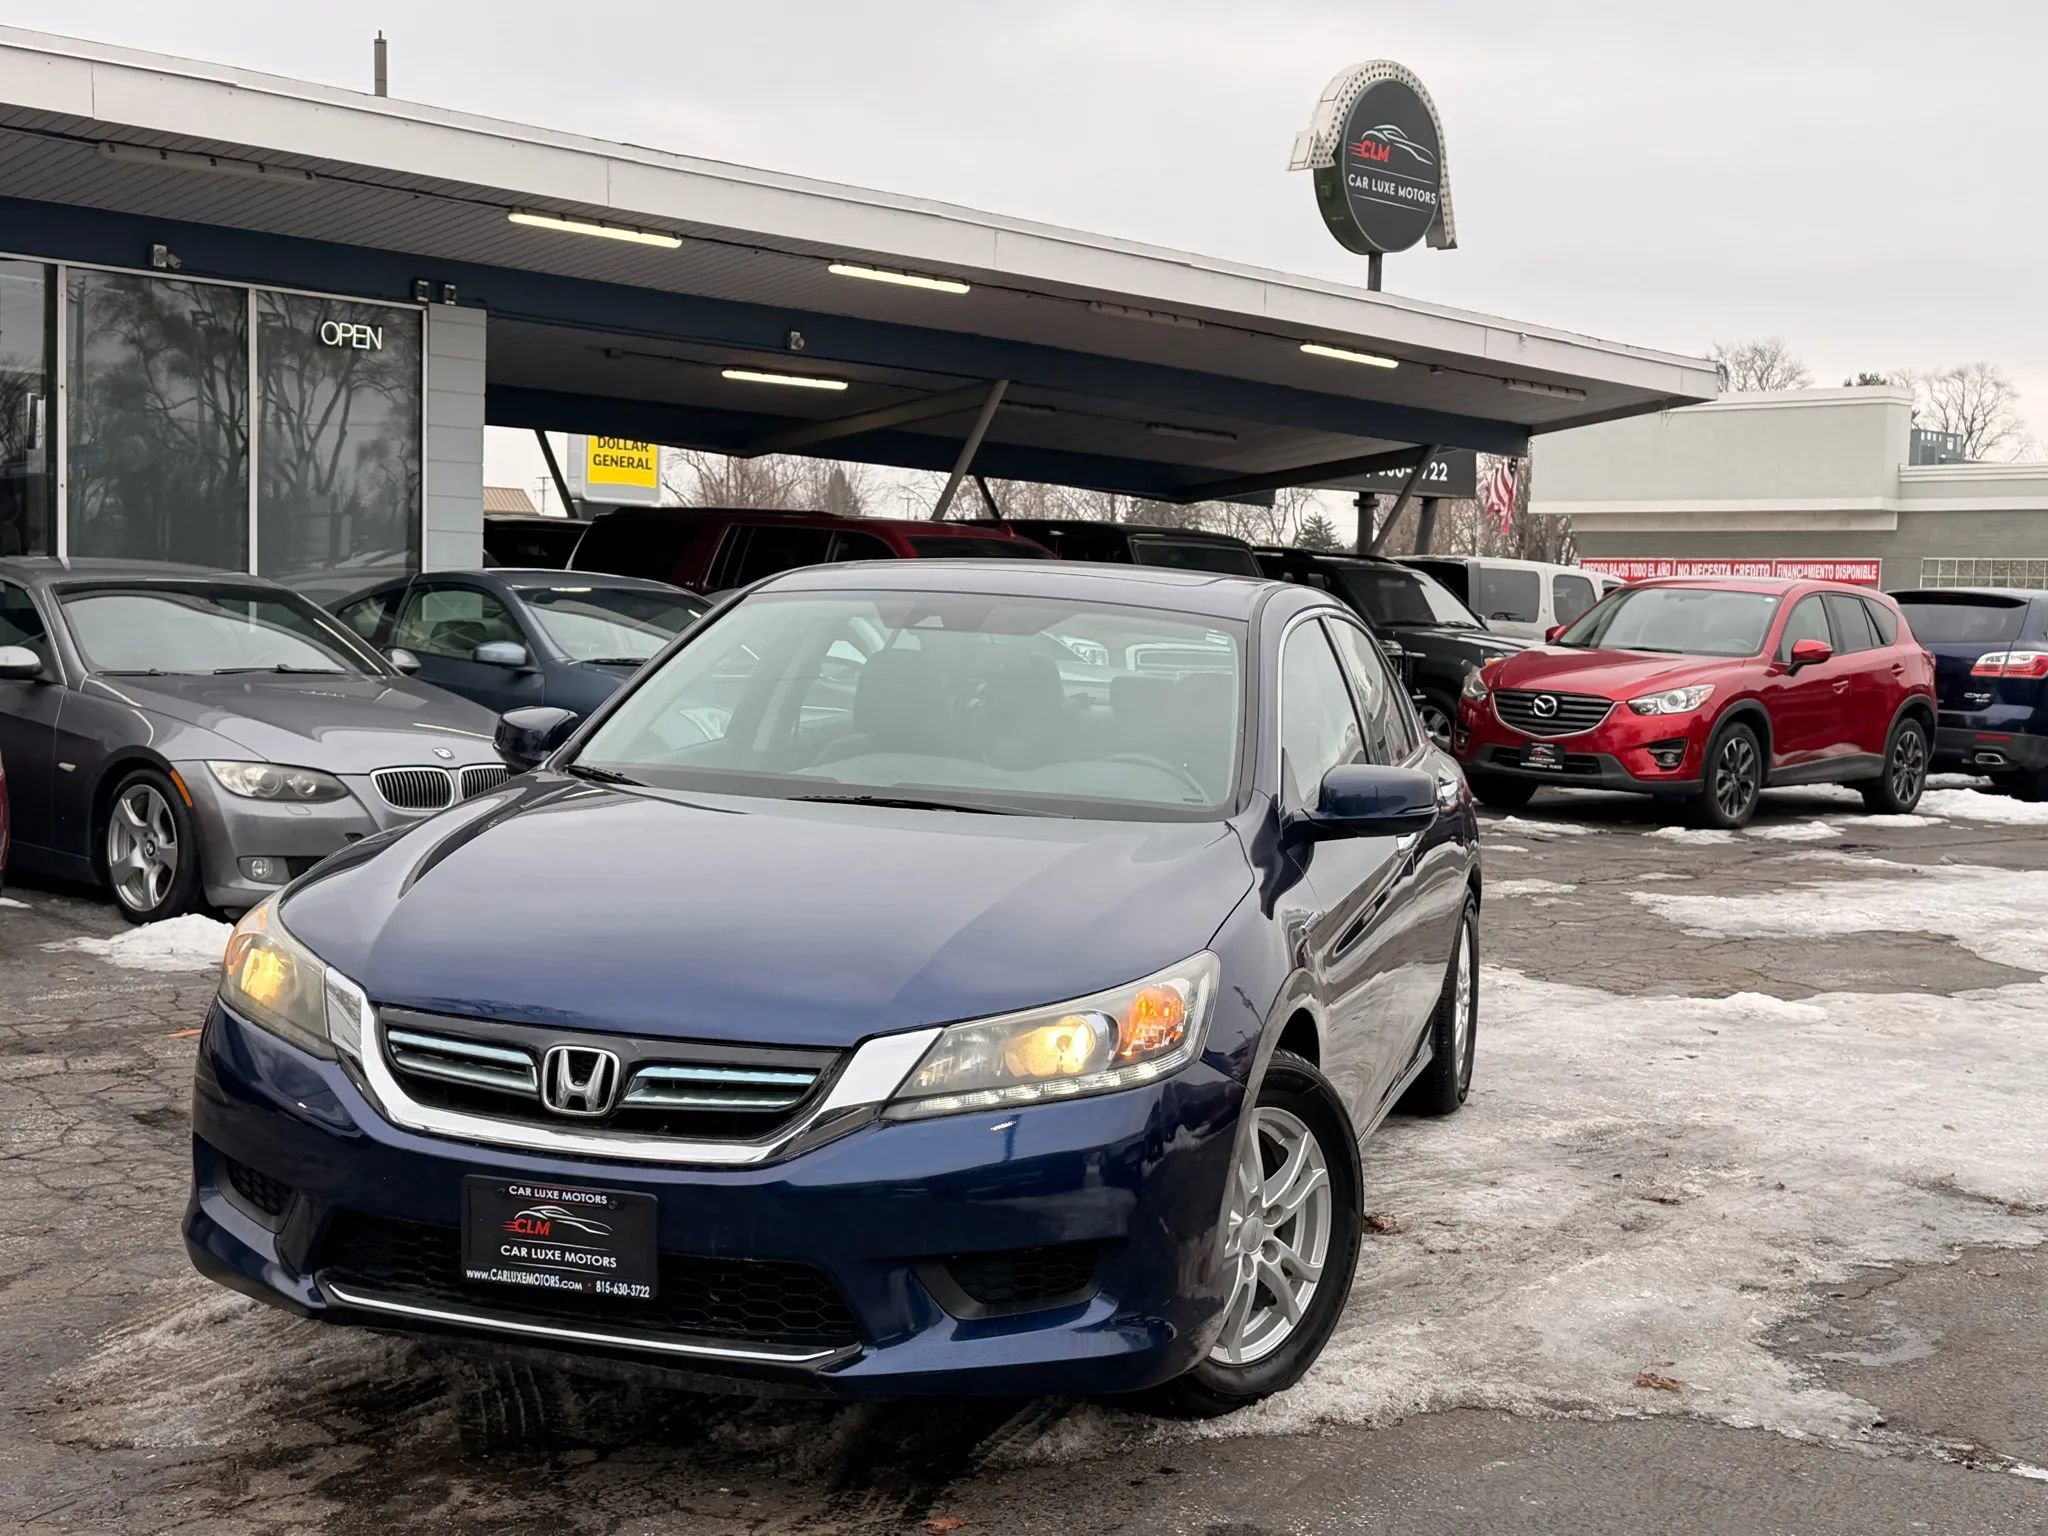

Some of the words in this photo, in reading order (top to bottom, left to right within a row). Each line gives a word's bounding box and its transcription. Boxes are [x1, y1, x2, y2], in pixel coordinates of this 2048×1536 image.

[1361, 140, 1391, 162] CLM
[1348, 173, 1369, 190] CAR
[1371, 178, 1396, 195] LUXE
[1398, 185, 1437, 205] MOTORS
[321, 321, 383, 350] OPEN
[597, 437, 649, 452] DOLLAR
[592, 453, 652, 471] GENERAL
[1630, 562, 1647, 577] TODO
[1648, 563, 1656, 577] EL
[1677, 563, 1690, 577] NO
[1835, 564, 1877, 579] DISPONIBLE
[508, 1185, 532, 1198] CAR
[534, 1188, 560, 1201] LUXE
[561, 1192, 608, 1206] MOTORS
[514, 1218, 551, 1237] CLM
[500, 1245, 528, 1259] CAR
[531, 1248, 562, 1262] LUXE
[564, 1252, 617, 1269] MOTORS
[595, 1280, 651, 1299] 815-630-3722
